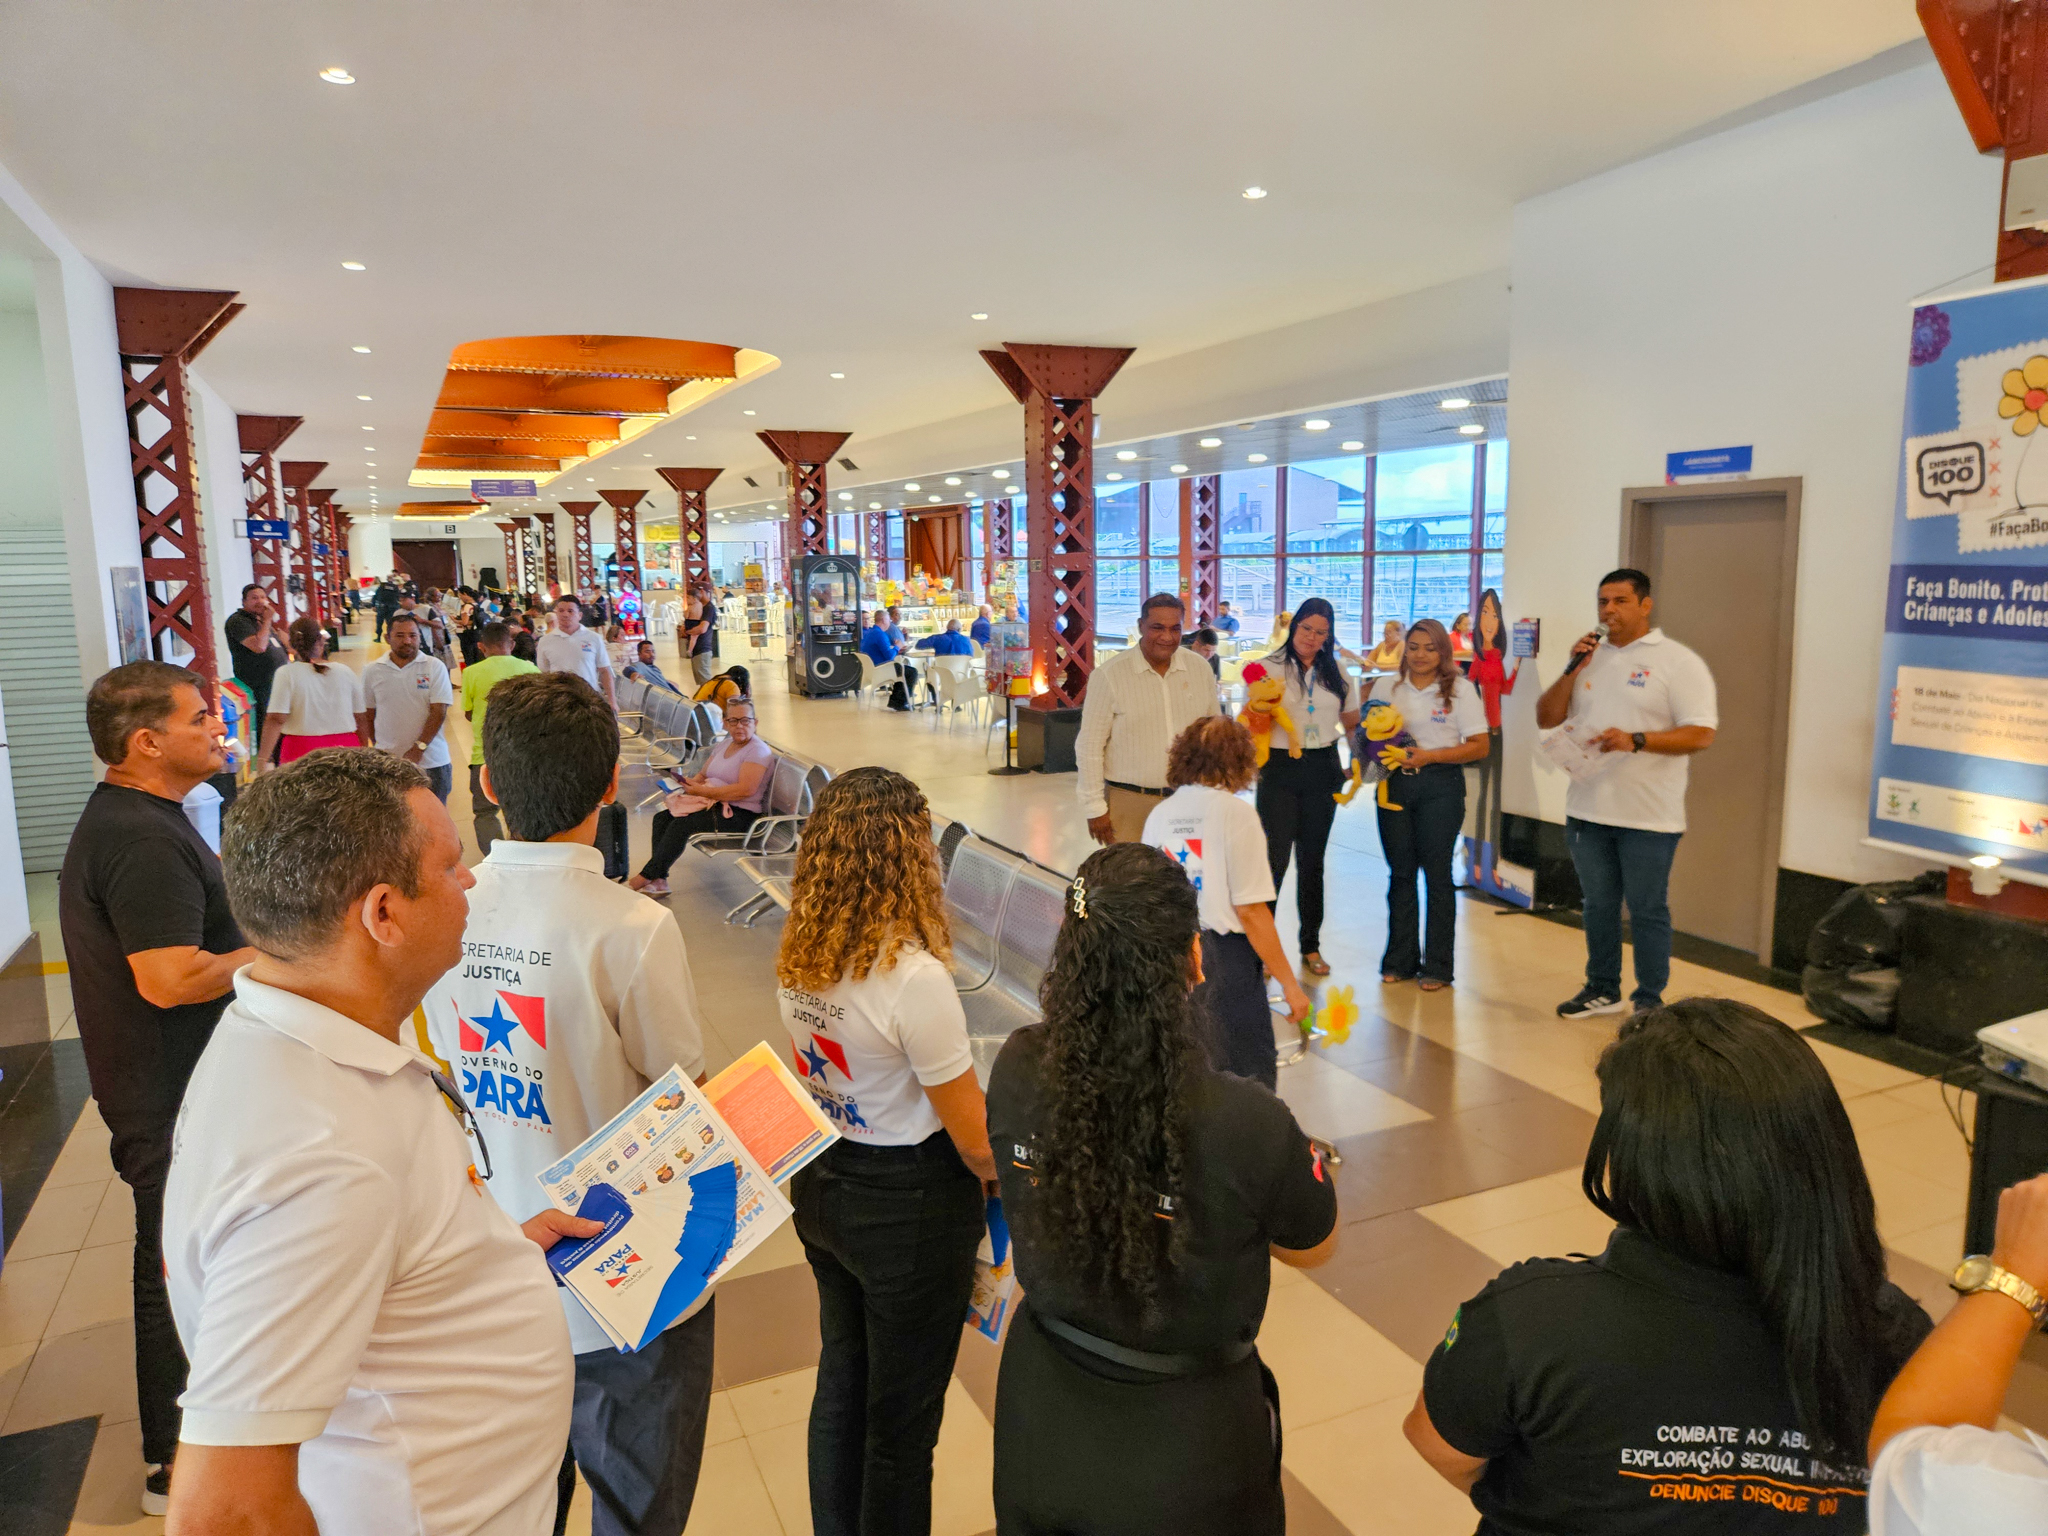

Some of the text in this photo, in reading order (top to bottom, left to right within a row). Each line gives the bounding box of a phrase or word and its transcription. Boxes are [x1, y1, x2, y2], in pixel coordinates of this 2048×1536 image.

[1929, 455, 1975, 470] DISQUE
[1928, 466, 1974, 486] 100
[1990, 518, 2048, 539] #FaçaBo
[1906, 576, 1943, 602] Faça
[1948, 578, 2005, 600] Bonito.
[1904, 600, 1973, 627] Crianças
[1978, 607, 1988, 624] e
[462, 941, 552, 966] RETARIA DE
[462, 965, 522, 987] JUSTIÇA
[782, 988, 845, 1020] ECRETARIA DE
[792, 1008, 828, 1031] JUSTIÇA
[461, 1055, 543, 1080] OVERNO DO
[808, 1082, 855, 1103] ERNO DO
[1656, 1425, 1739, 1444] COMBATE
[1746, 1428, 1771, 1445] AO
[1621, 1446, 1734, 1474] EXPLORAÇÃO
[1740, 1452, 1804, 1476] SEXUAL
[1650, 1483, 1736, 1502] DENUNCIE
[1742, 1484, 1809, 1513] DISQUE
